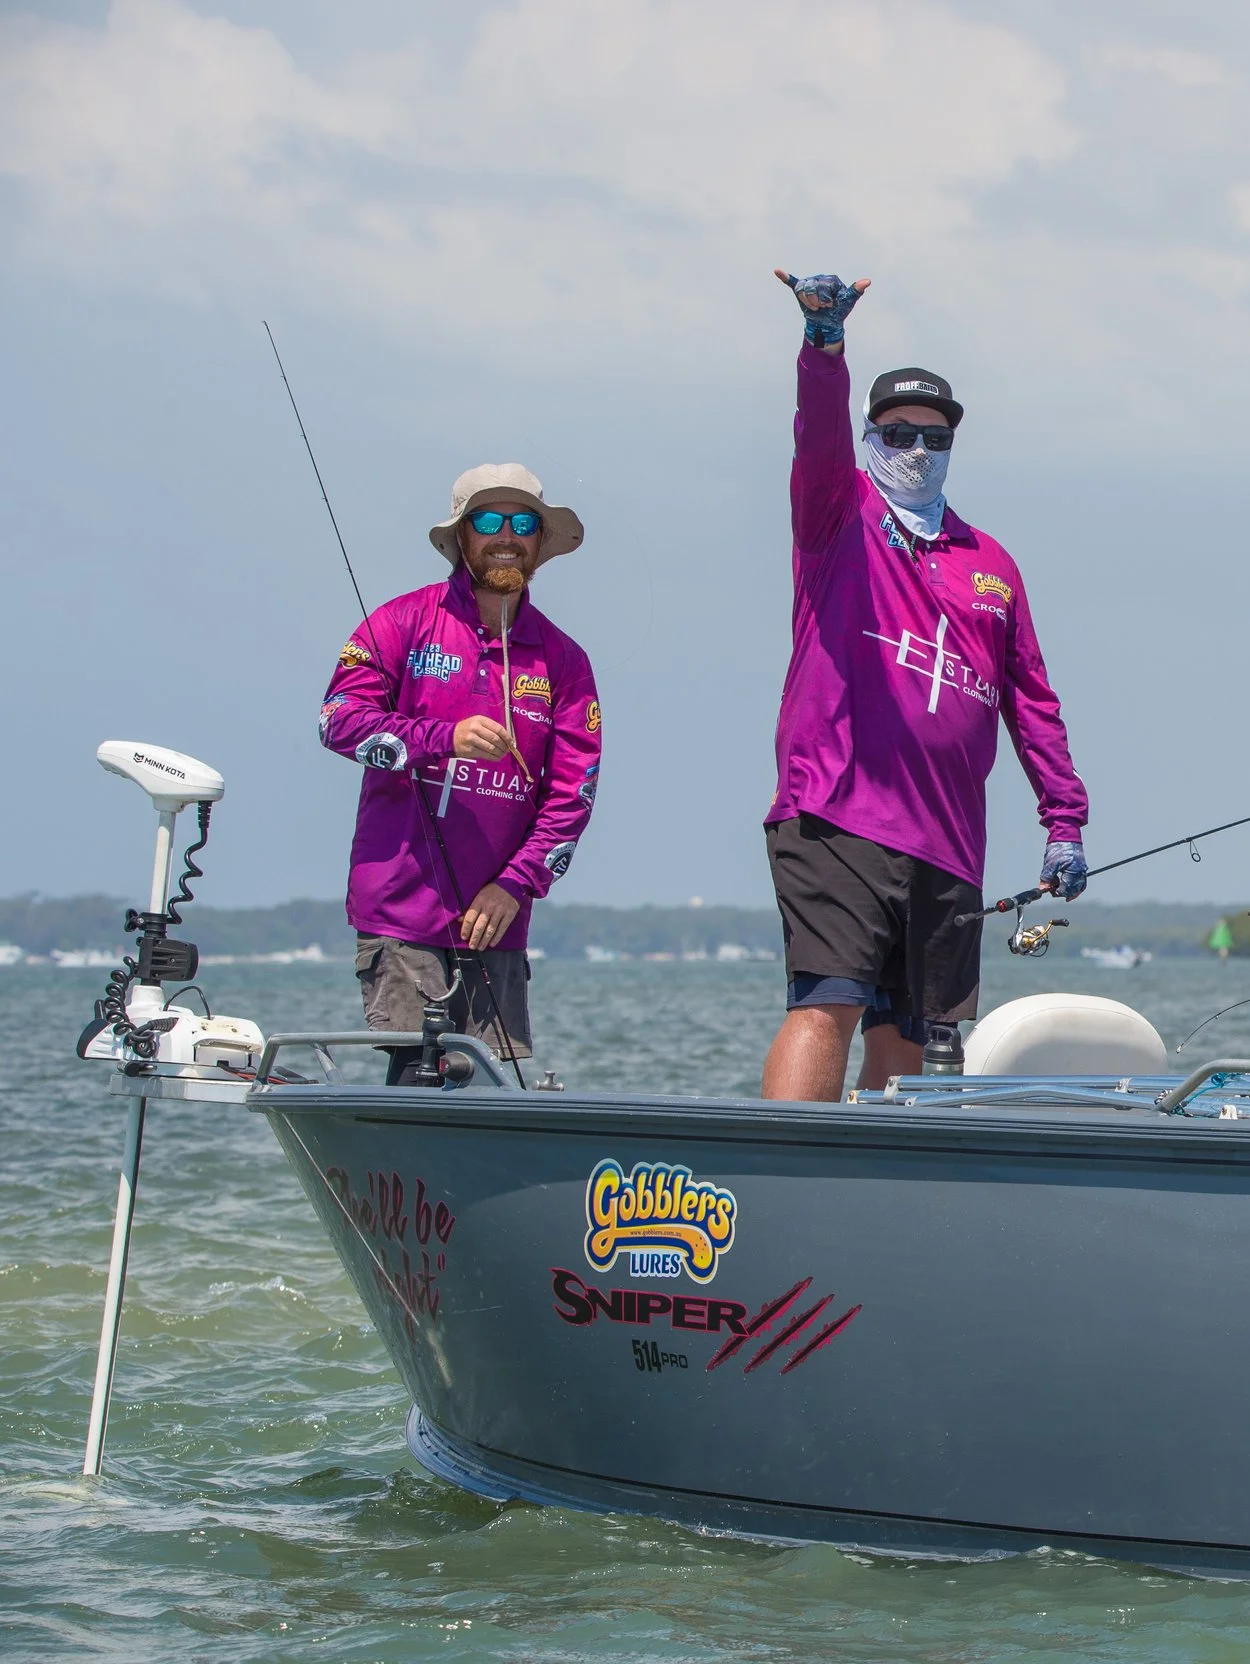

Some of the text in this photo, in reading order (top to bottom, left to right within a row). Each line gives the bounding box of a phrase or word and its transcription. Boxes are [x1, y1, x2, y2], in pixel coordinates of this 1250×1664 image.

[407, 650, 461, 672] FLHEAD
[144, 757, 186, 779] MINN KOTA
[476, 787, 513, 800] CLOTHING
[590, 1167, 733, 1271] Gobblers
[631, 1252, 681, 1275] LURES
[549, 1267, 750, 1337] SNIPER
